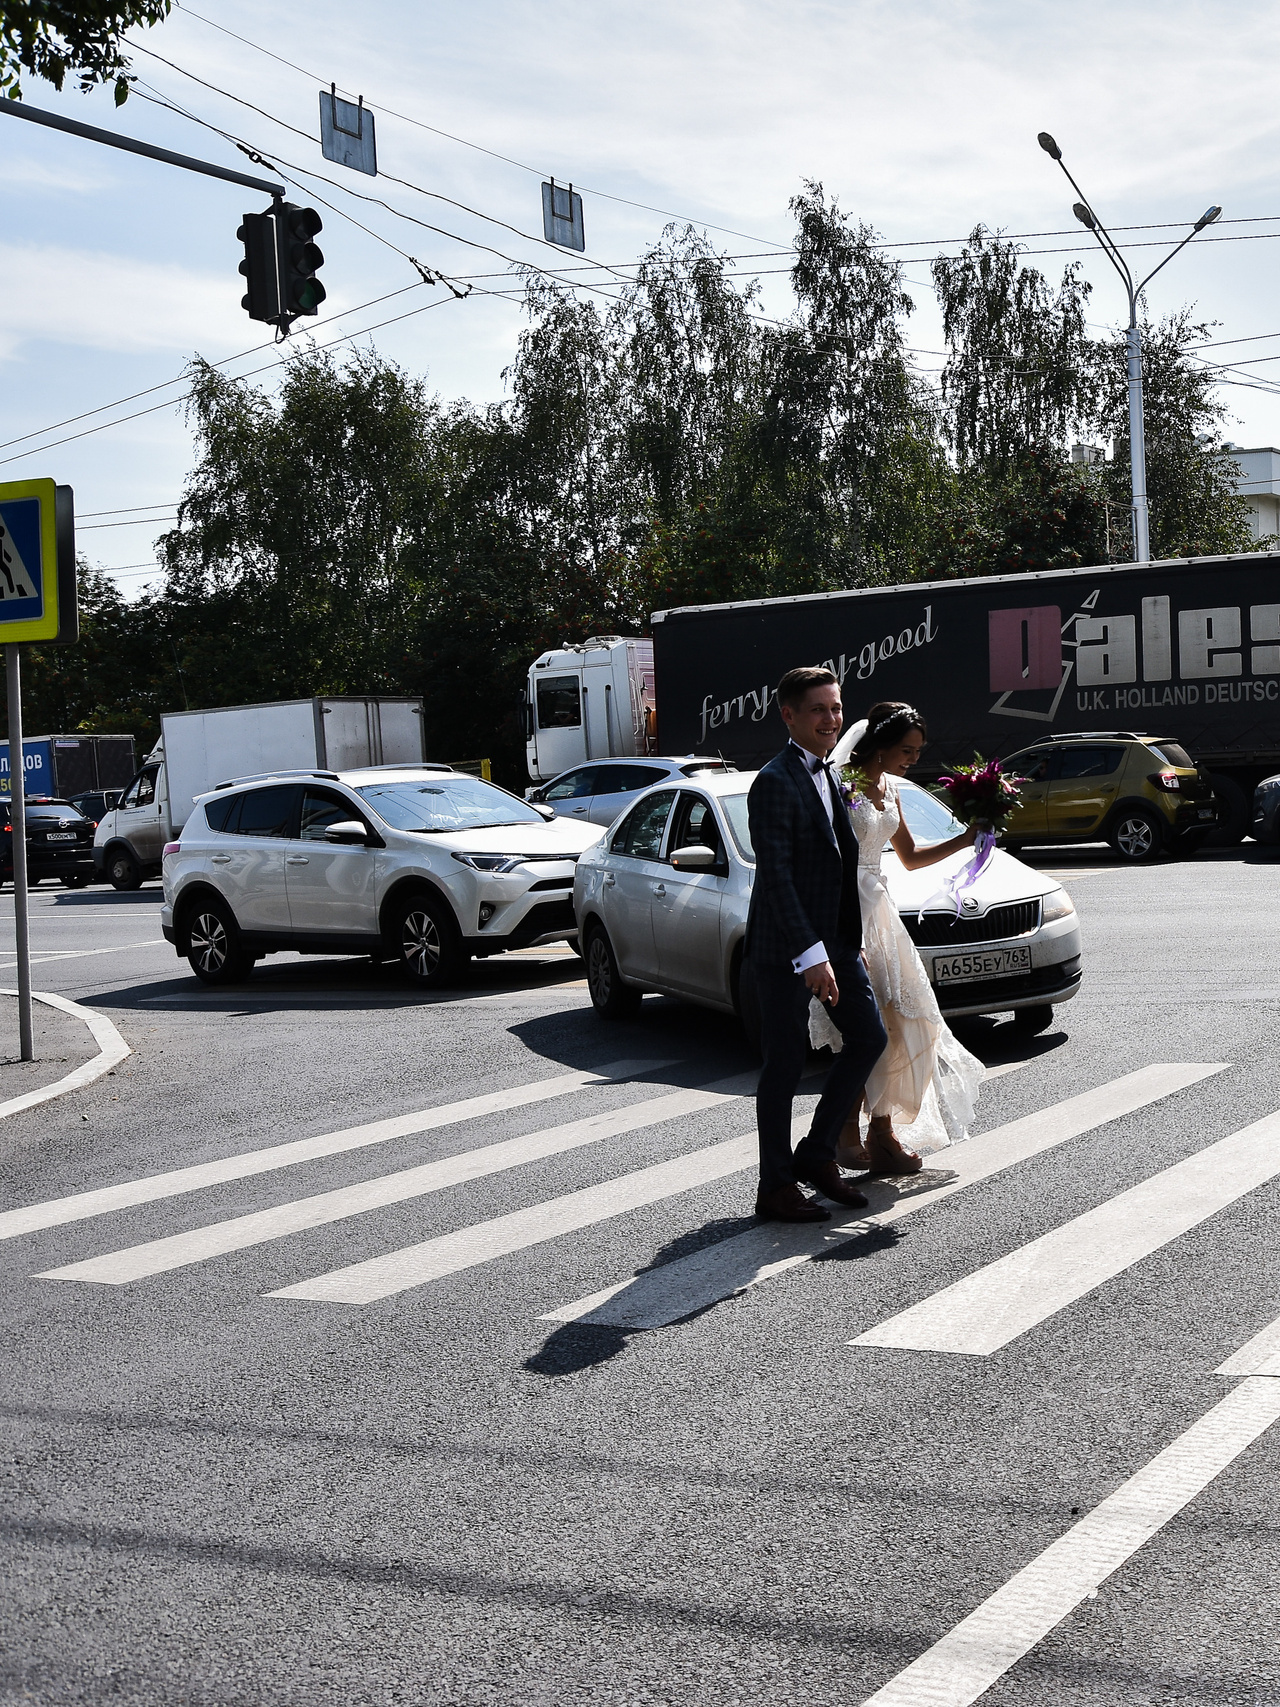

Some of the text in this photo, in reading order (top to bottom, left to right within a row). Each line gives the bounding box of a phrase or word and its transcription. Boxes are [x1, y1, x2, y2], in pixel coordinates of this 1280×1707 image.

[1076, 691, 1110, 712] U.K.
[1115, 684, 1200, 709] HOLLAND
[1004, 949, 1026, 964] 763
